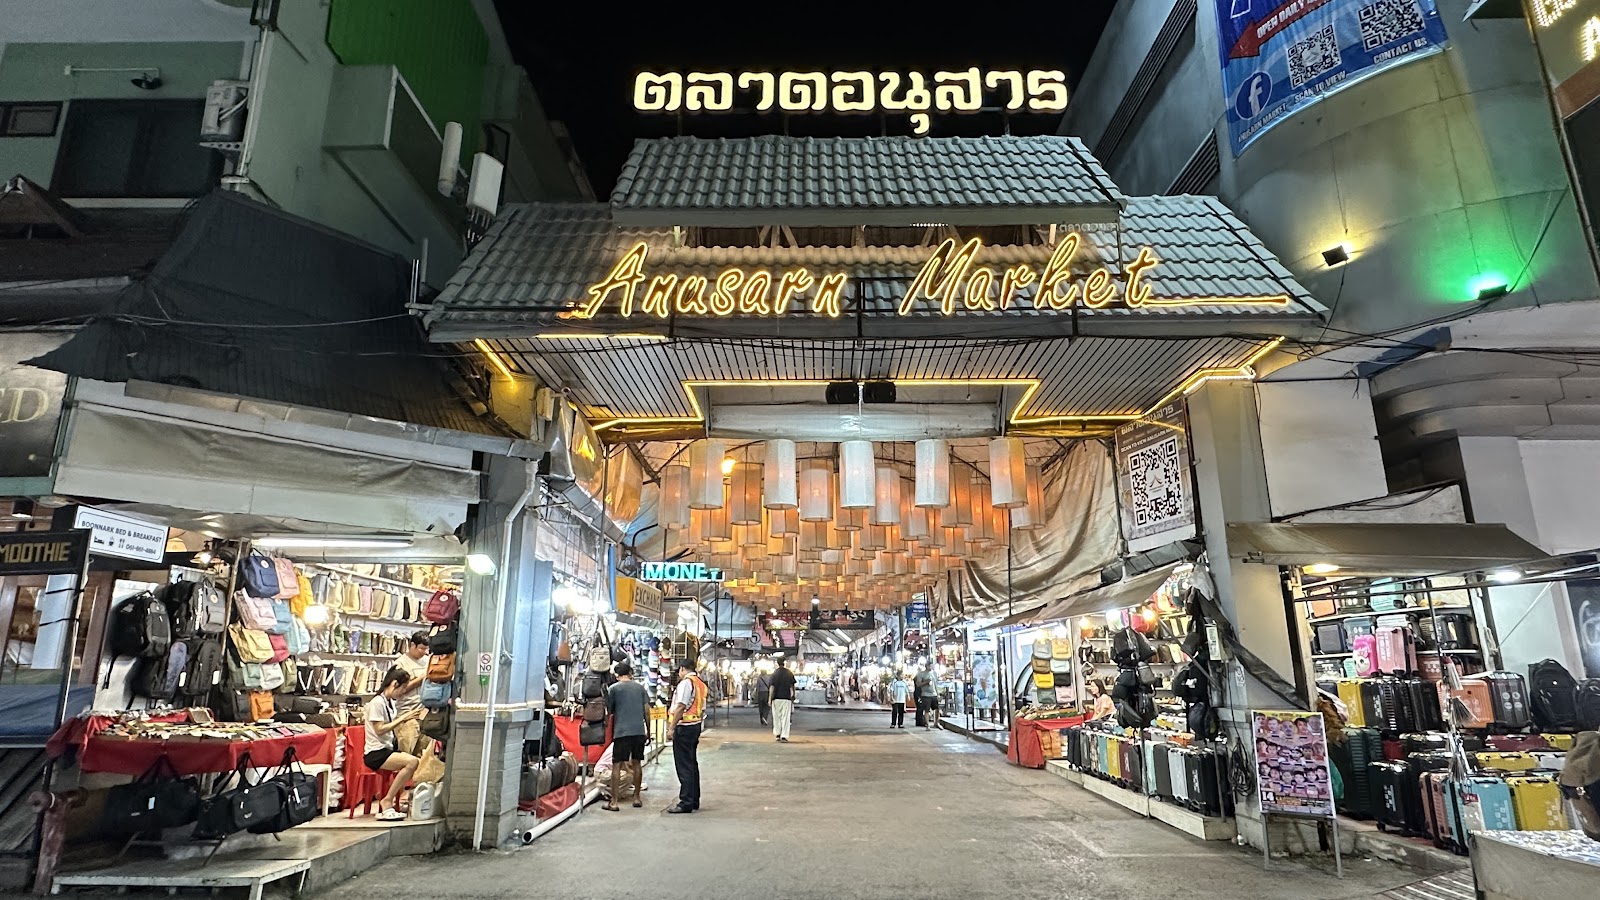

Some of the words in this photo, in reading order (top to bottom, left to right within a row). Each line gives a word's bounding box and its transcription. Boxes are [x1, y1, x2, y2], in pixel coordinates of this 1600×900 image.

[1256, 15, 1278, 38] OPEN
[1373, 41, 1412, 63] CONTACT
[1413, 37, 1428, 48] US
[1294, 87, 1314, 104] SCAN
[1315, 81, 1325, 92] TO
[1325, 70, 1347, 87] VIEW
[633, 67, 1069, 134] ตลาดอนุสาร
[1262, 102, 1287, 125] MARKET
[587, 241, 848, 319] Anusarn
[898, 232, 1160, 317] Market
[81, 520, 114, 534] BOONNARK
[115, 527, 127, 536] BED
[133, 532, 162, 543] BREAKFAST
[480, 664, 492, 672] NO
[1262, 791, 1274, 801] 14
